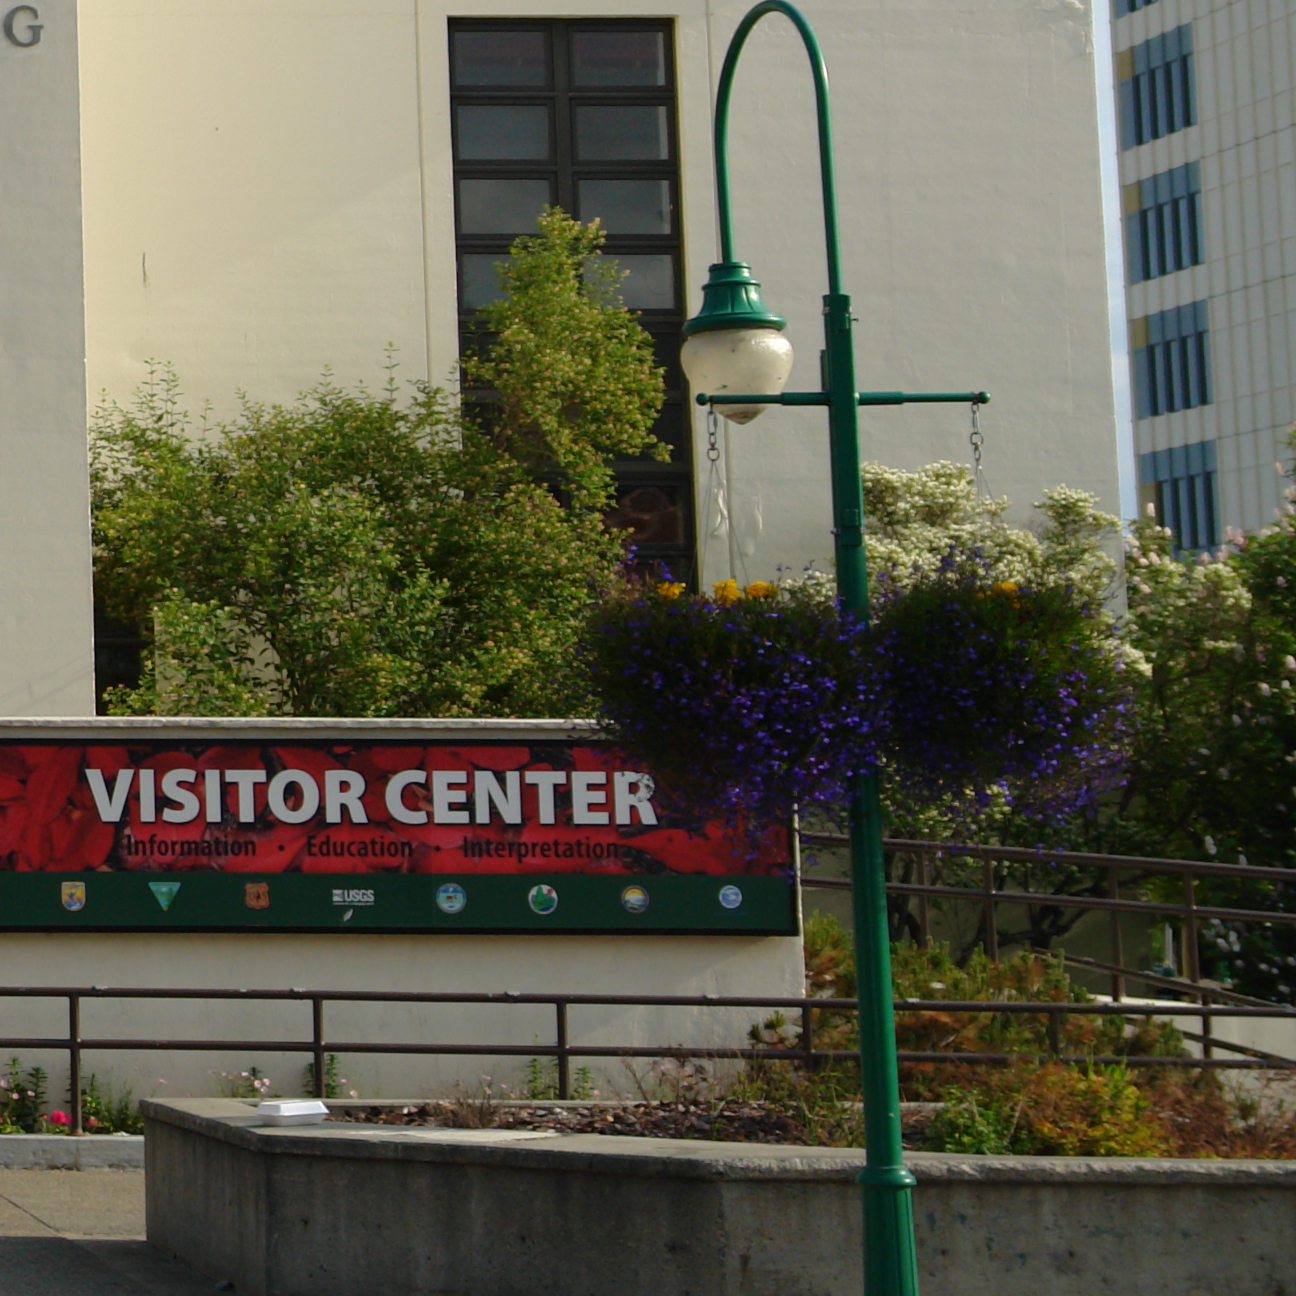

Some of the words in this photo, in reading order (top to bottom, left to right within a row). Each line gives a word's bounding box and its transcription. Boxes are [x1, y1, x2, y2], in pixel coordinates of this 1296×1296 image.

[85, 768, 369, 824] VISITOR
[385, 769, 658, 825] CENTER
[126, 834, 257, 856] Information
[308, 835, 413, 857] Education
[464, 836, 618, 863] Interpretation
[345, 889, 375, 901] USGS
